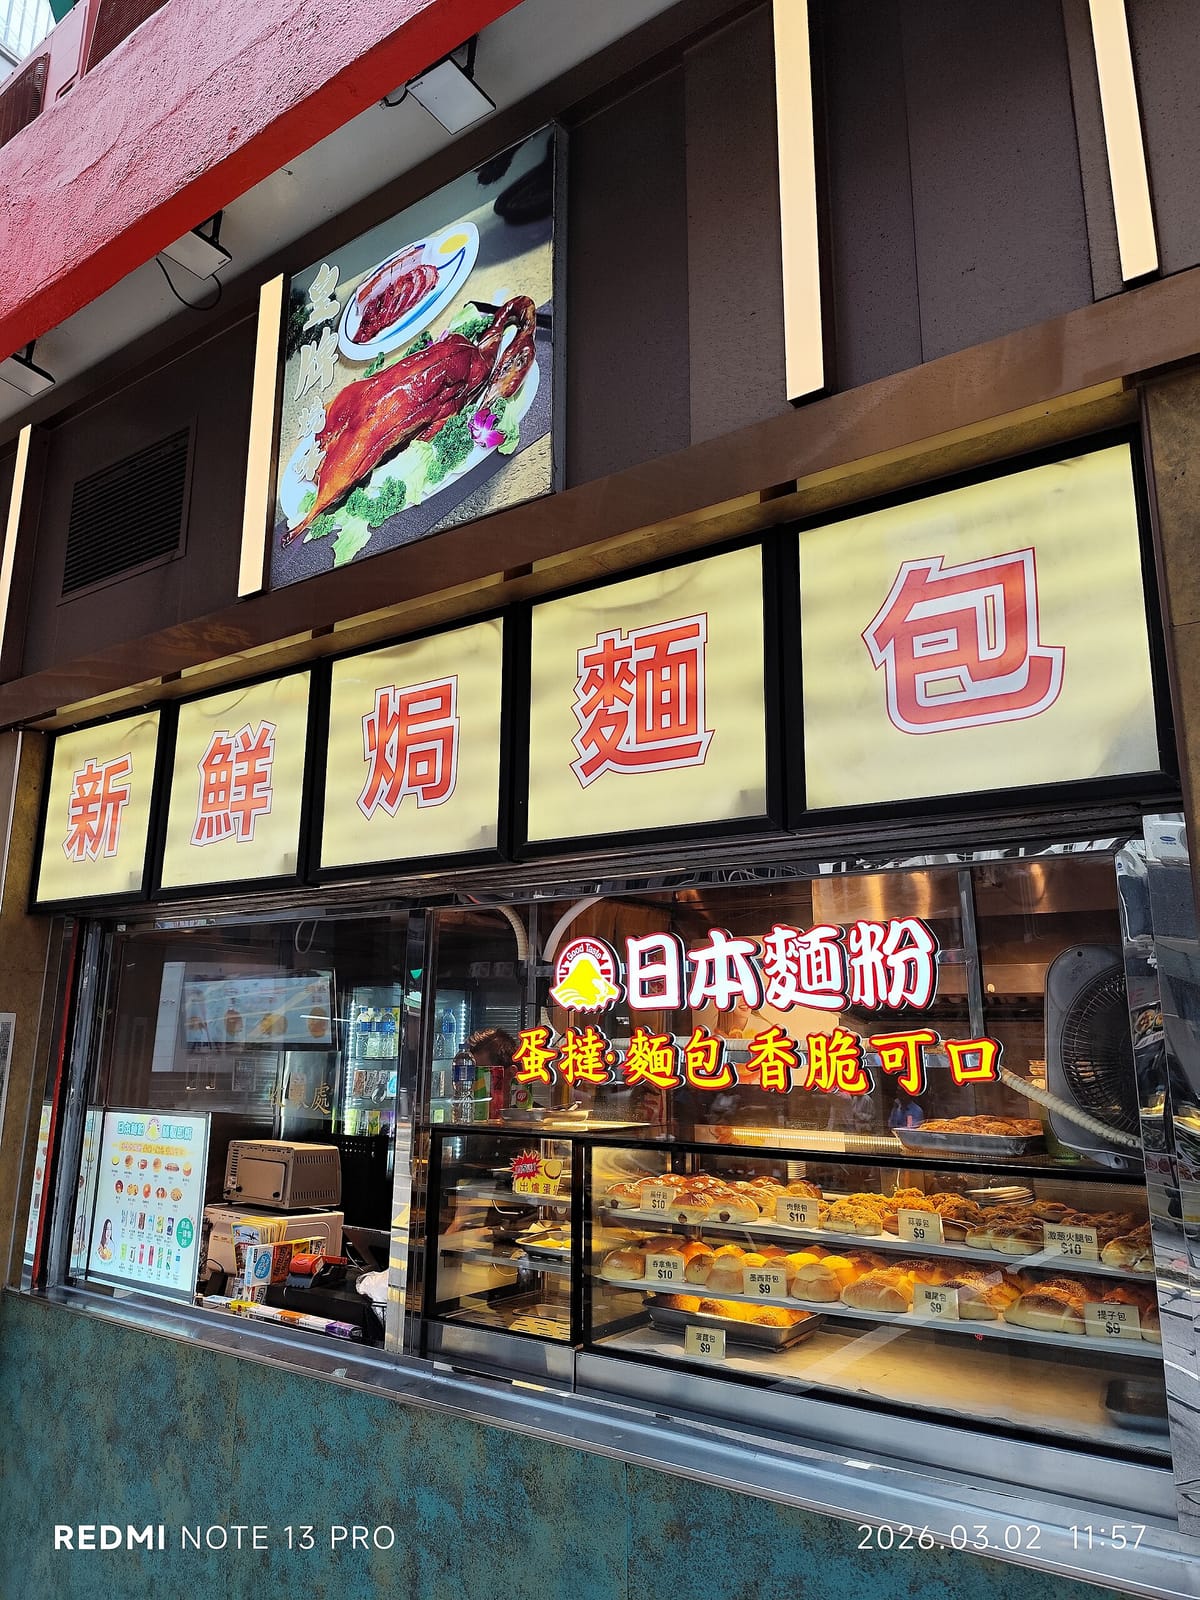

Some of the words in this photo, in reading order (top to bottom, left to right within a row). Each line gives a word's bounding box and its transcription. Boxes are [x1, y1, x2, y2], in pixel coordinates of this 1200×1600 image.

[63, 547, 1065, 862] 新鮮焗麵包
[566, 944, 584, 960] Good
[585, 943, 602, 959] Taste
[625, 917, 935, 1011] 日本麵粉
[652, 1199, 666, 1210] $10
[789, 1212, 806, 1223] $10
[913, 1228, 925, 1239] $9
[1061, 1242, 1082, 1255] $10
[657, 1269, 673, 1280] $10
[759, 1284, 771, 1294] $9
[930, 1301, 942, 1313] $9
[1105, 1321, 1121, 1334] $9
[700, 1343, 711, 1354] $9
